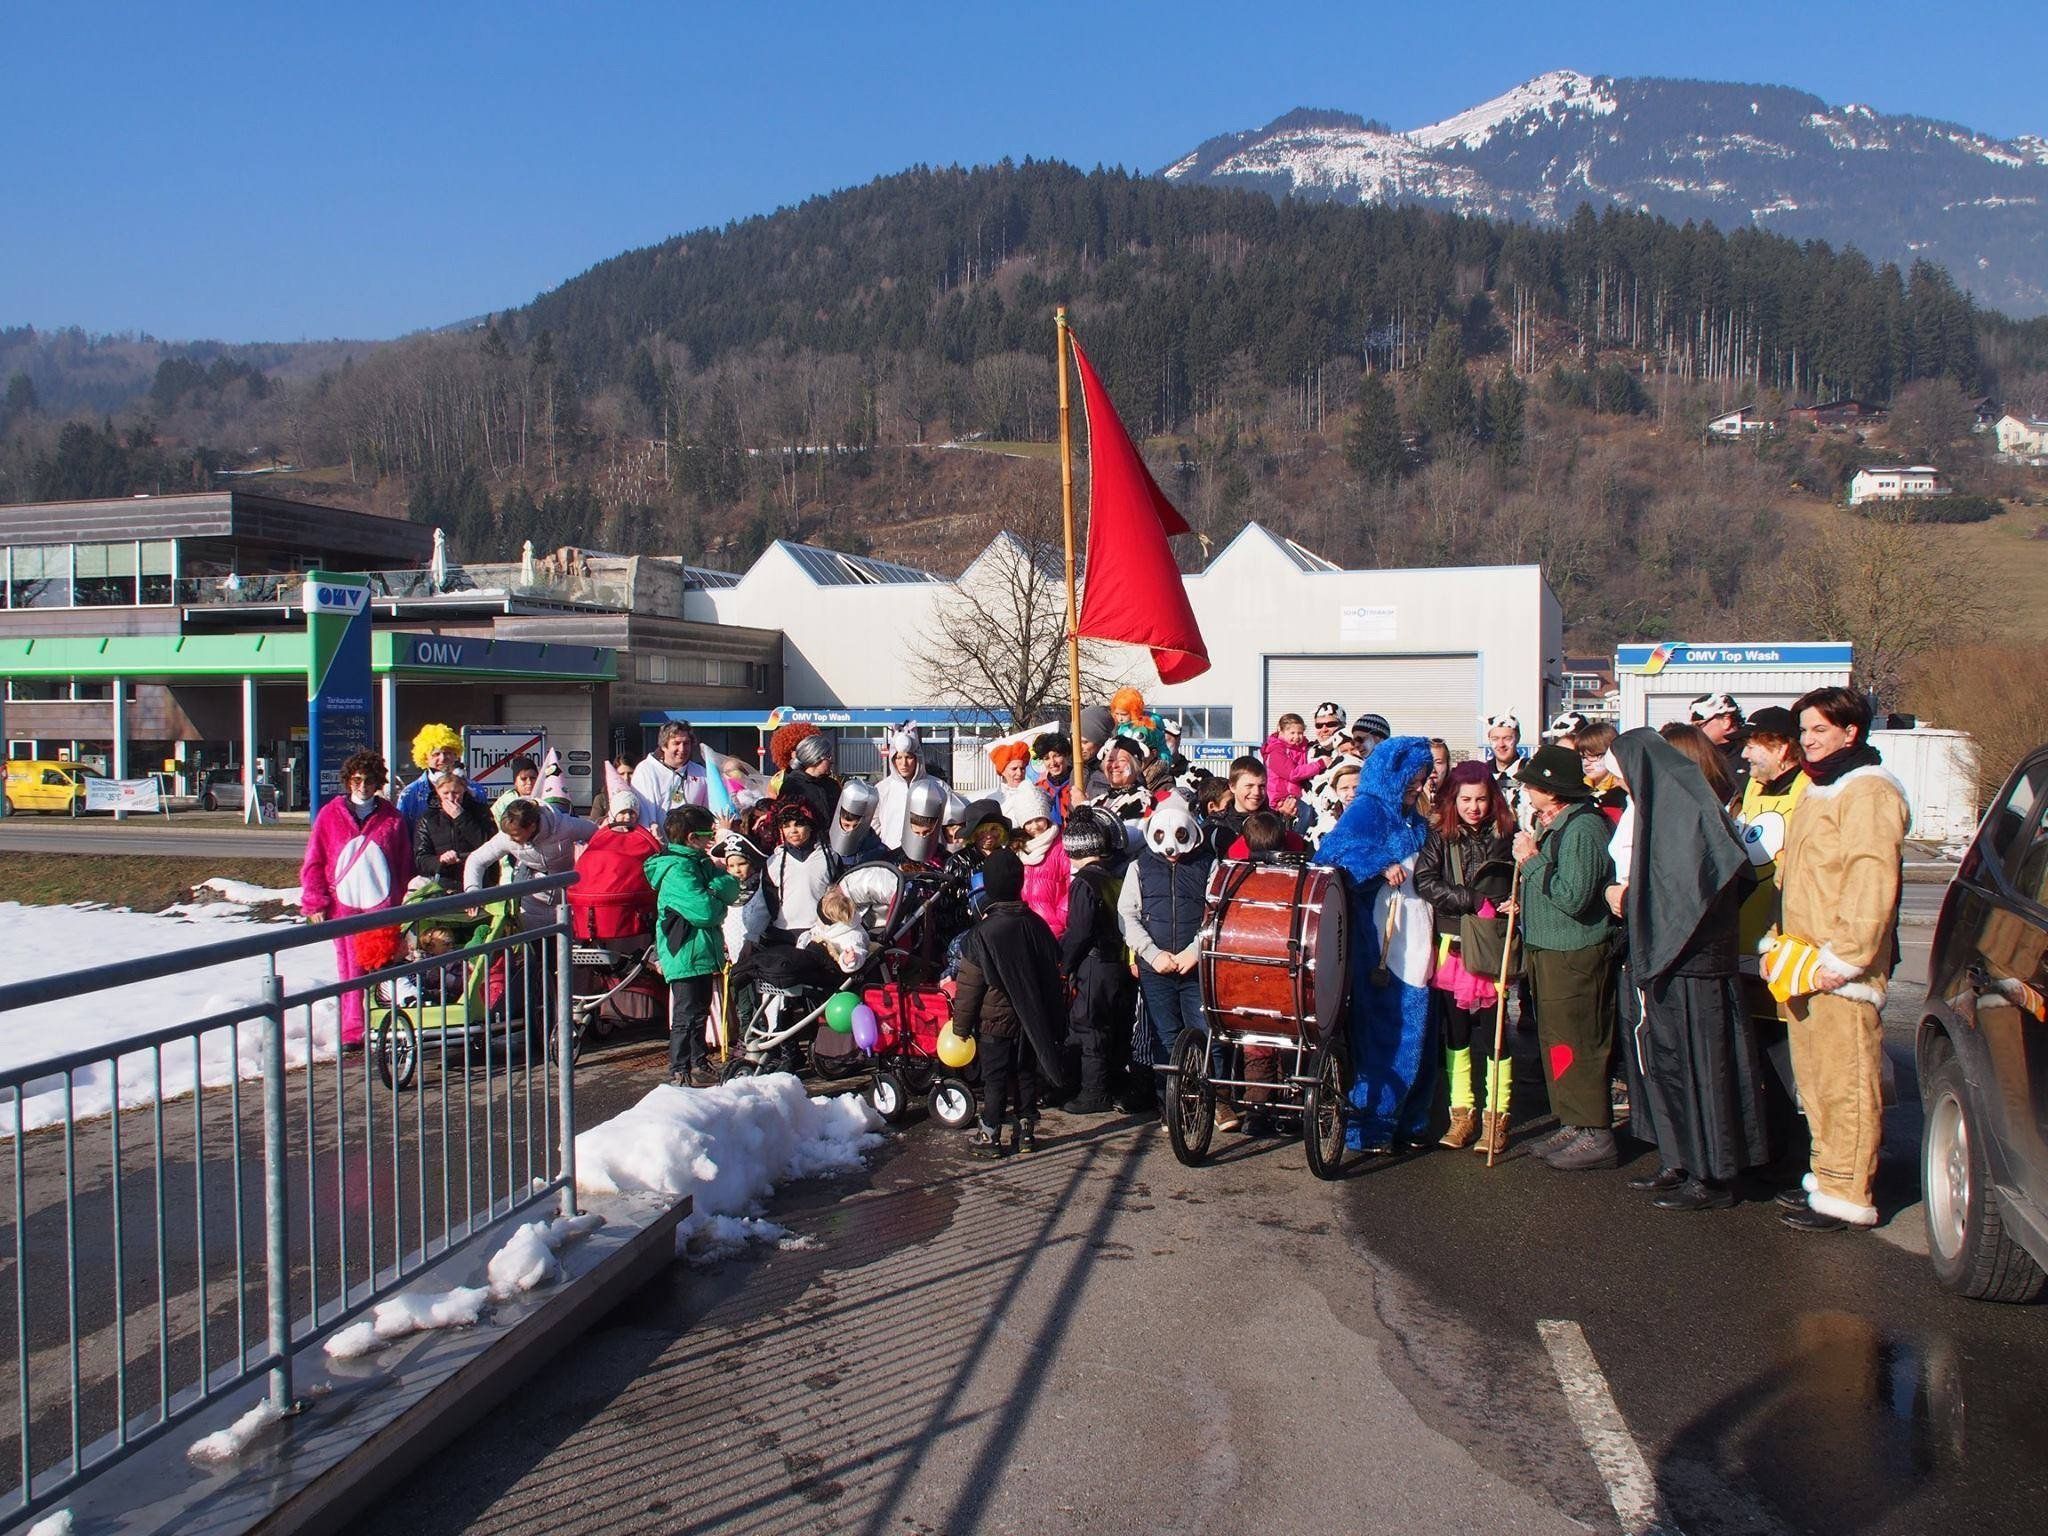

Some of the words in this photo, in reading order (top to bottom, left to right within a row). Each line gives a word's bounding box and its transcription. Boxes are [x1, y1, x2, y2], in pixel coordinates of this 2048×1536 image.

[317, 587, 362, 606] OMV
[418, 642, 463, 664] OMV
[1686, 651, 1717, 661] OMV
[1720, 651, 1742, 663] Top
[1745, 650, 1780, 661] Wash
[792, 713, 812, 721] OMV
[814, 713, 828, 722] Top
[829, 713, 850, 721] Wash
